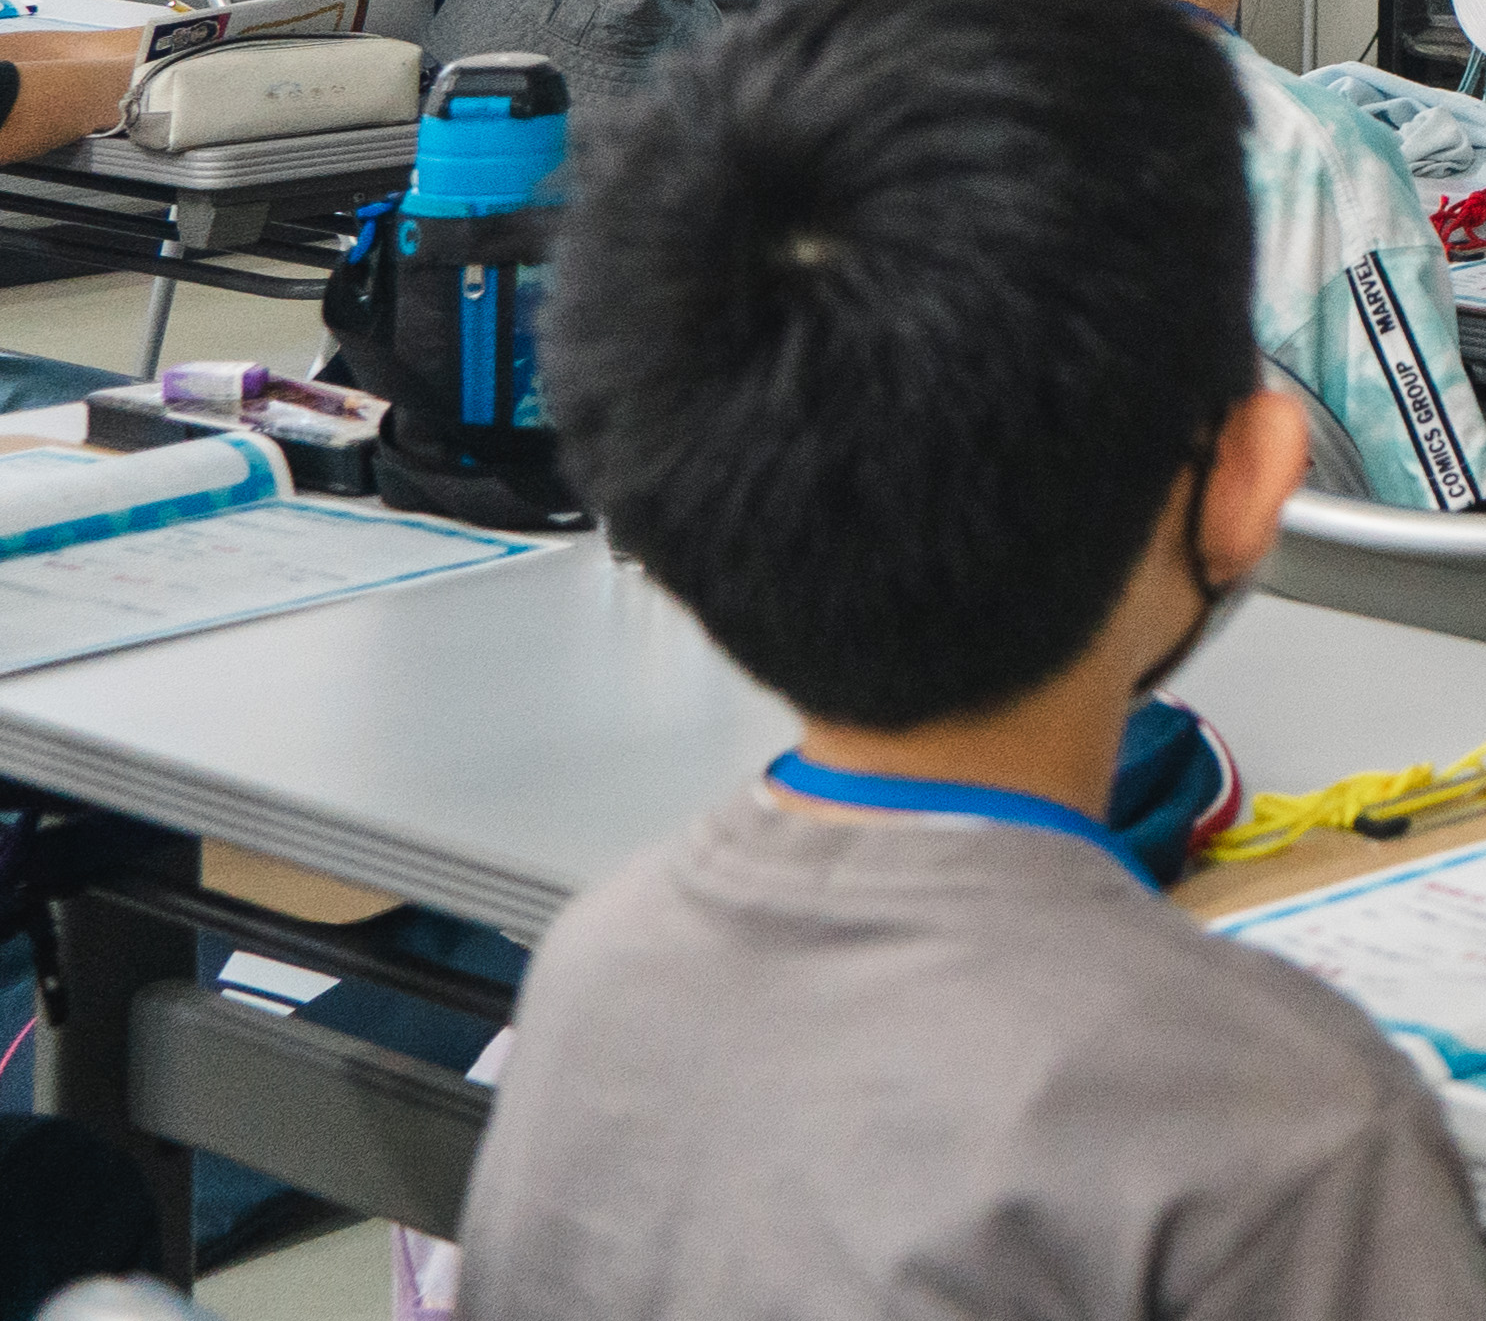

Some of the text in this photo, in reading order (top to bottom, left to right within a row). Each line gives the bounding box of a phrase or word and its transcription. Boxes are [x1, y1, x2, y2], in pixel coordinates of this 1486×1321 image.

[1354, 252, 1466, 499] COMICS GROUP MARVEL
